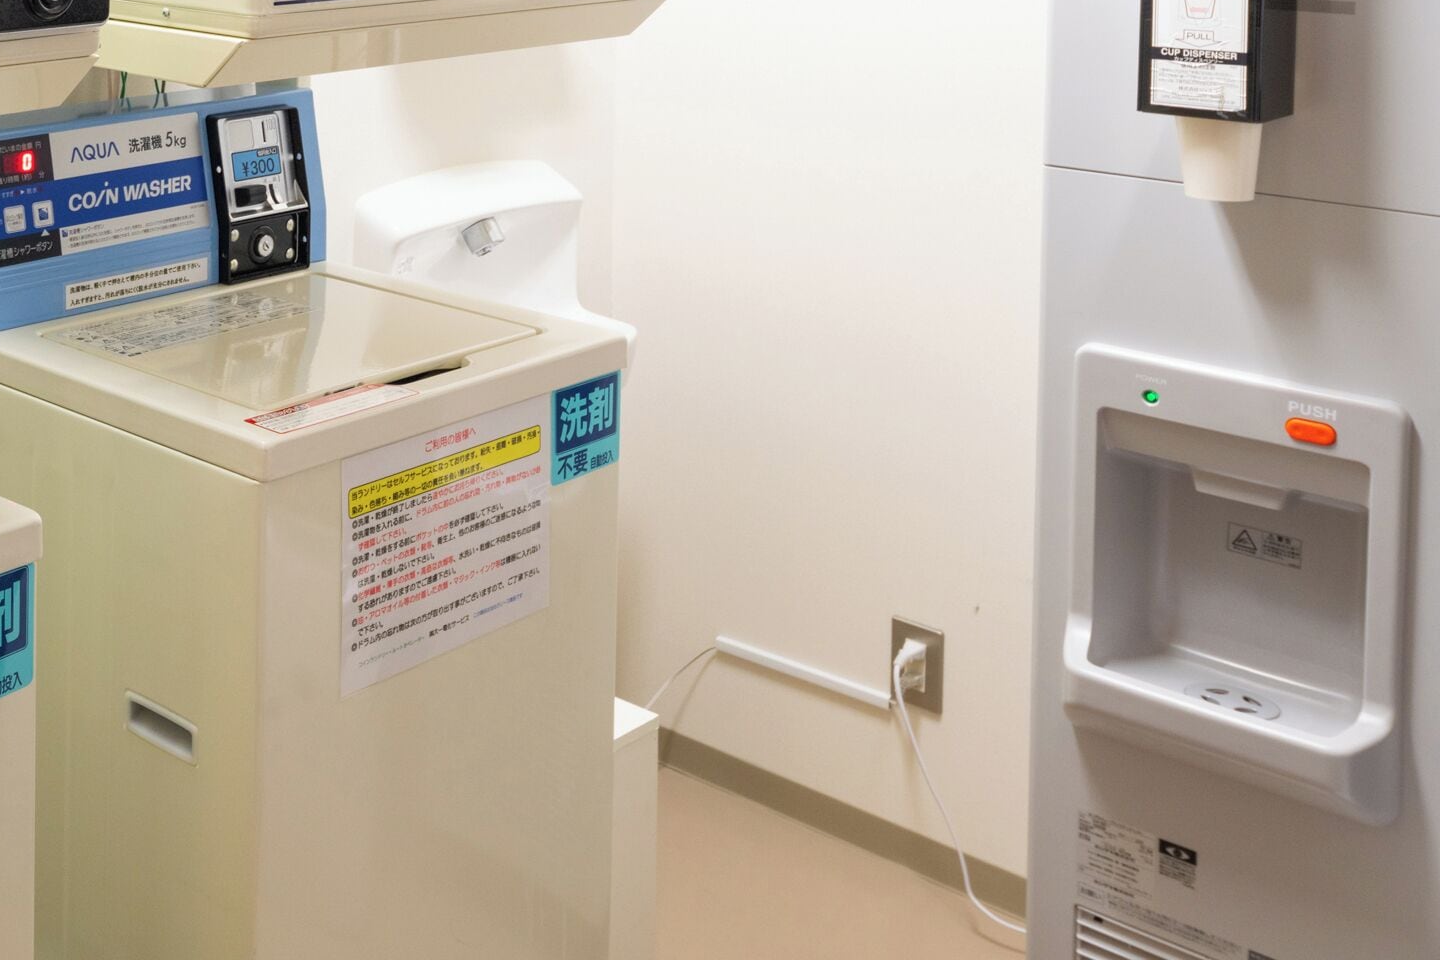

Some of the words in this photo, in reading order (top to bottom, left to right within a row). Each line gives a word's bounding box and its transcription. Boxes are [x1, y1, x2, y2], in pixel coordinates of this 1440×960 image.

[1186, 32, 1212, 40] PULL
[1161, 48, 1180, 56] CUP
[1183, 49, 1237, 60] DISPENSER
[70, 141, 120, 164] AQUA
[128, 135, 162, 153] 洗濯機
[165, 131, 187, 149] 5kg
[22, 153, 32, 171] 0
[242, 158, 275, 177] ¥300
[123, 175, 191, 203] WASHER
[560, 382, 614, 443] 洗剤
[1288, 400, 1337, 421] PUSH
[425, 427, 476, 453] ご利用の皆様へ
[558, 448, 588, 480] 不要
